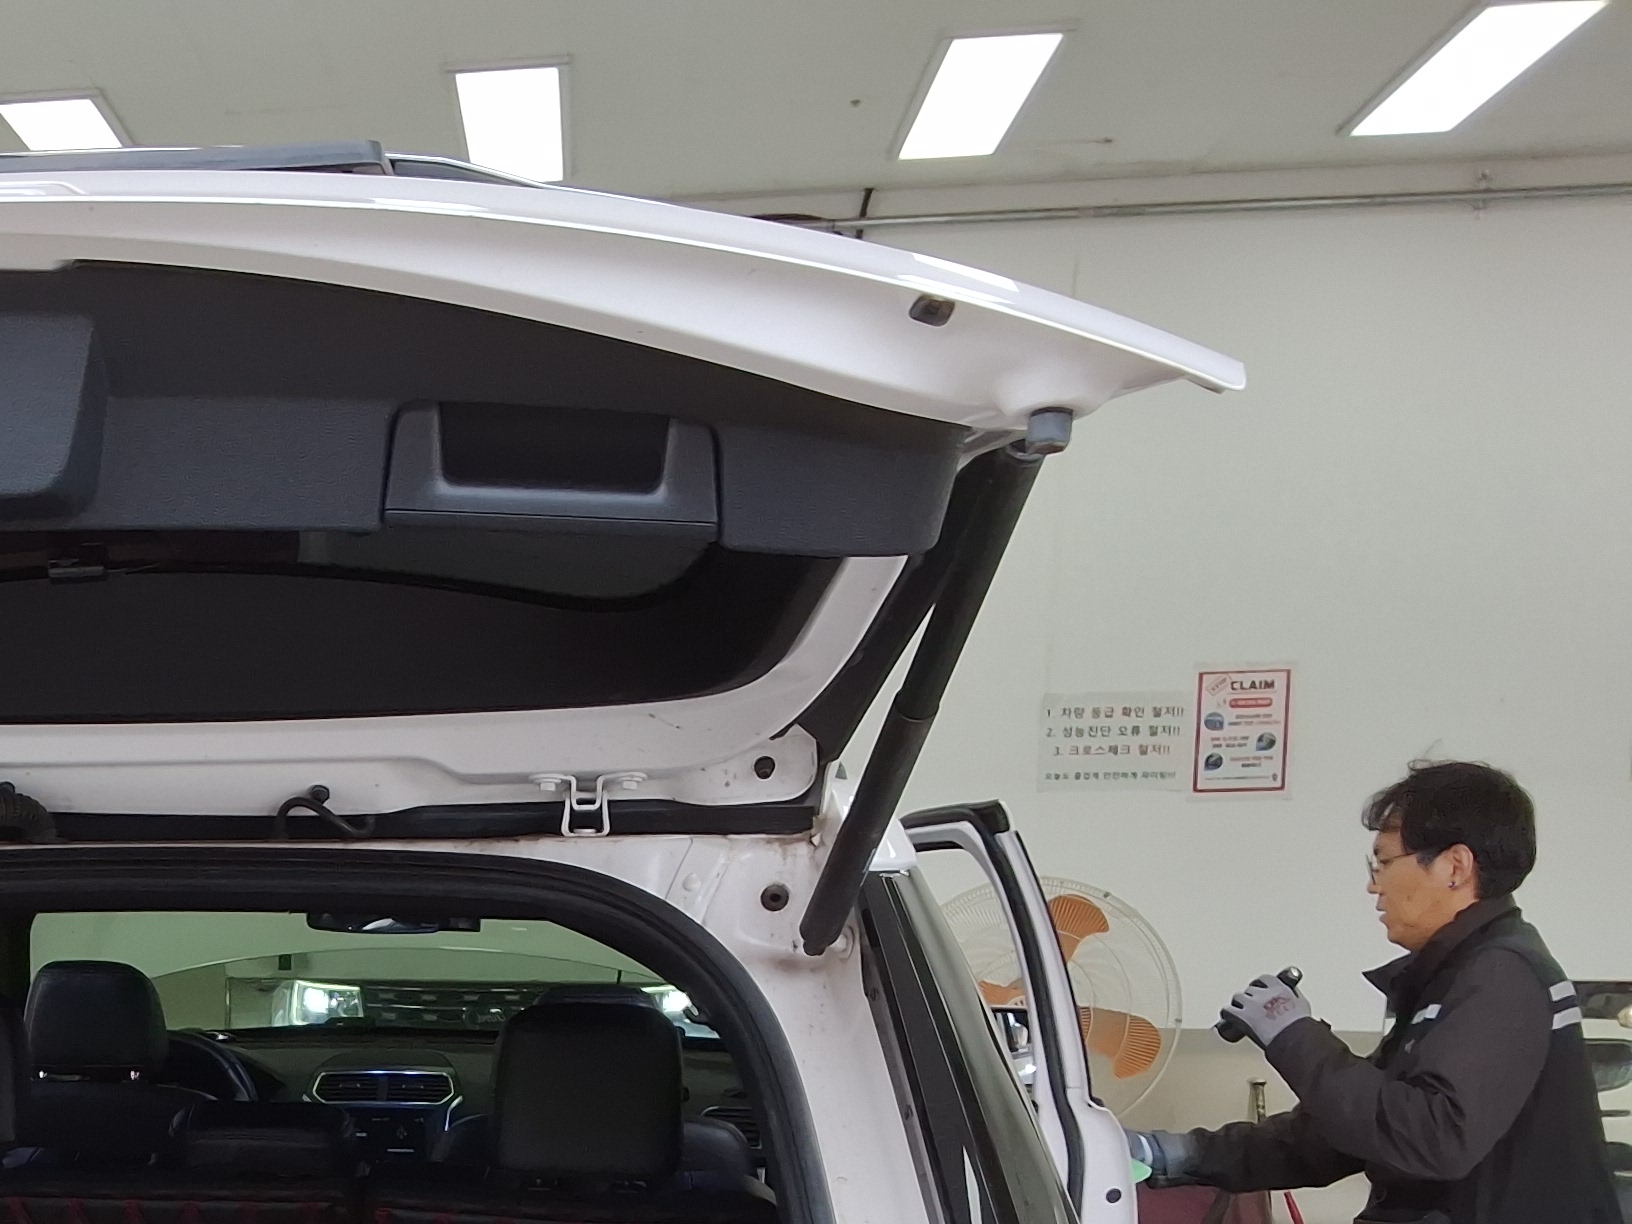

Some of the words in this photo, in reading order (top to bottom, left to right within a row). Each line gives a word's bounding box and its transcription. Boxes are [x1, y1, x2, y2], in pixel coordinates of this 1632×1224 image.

[1230, 679, 1275, 691] CLAIM
[1061, 706, 1085, 719] 차량
[1121, 706, 1145, 718] 확인
[1046, 727, 1056, 738] 2.
